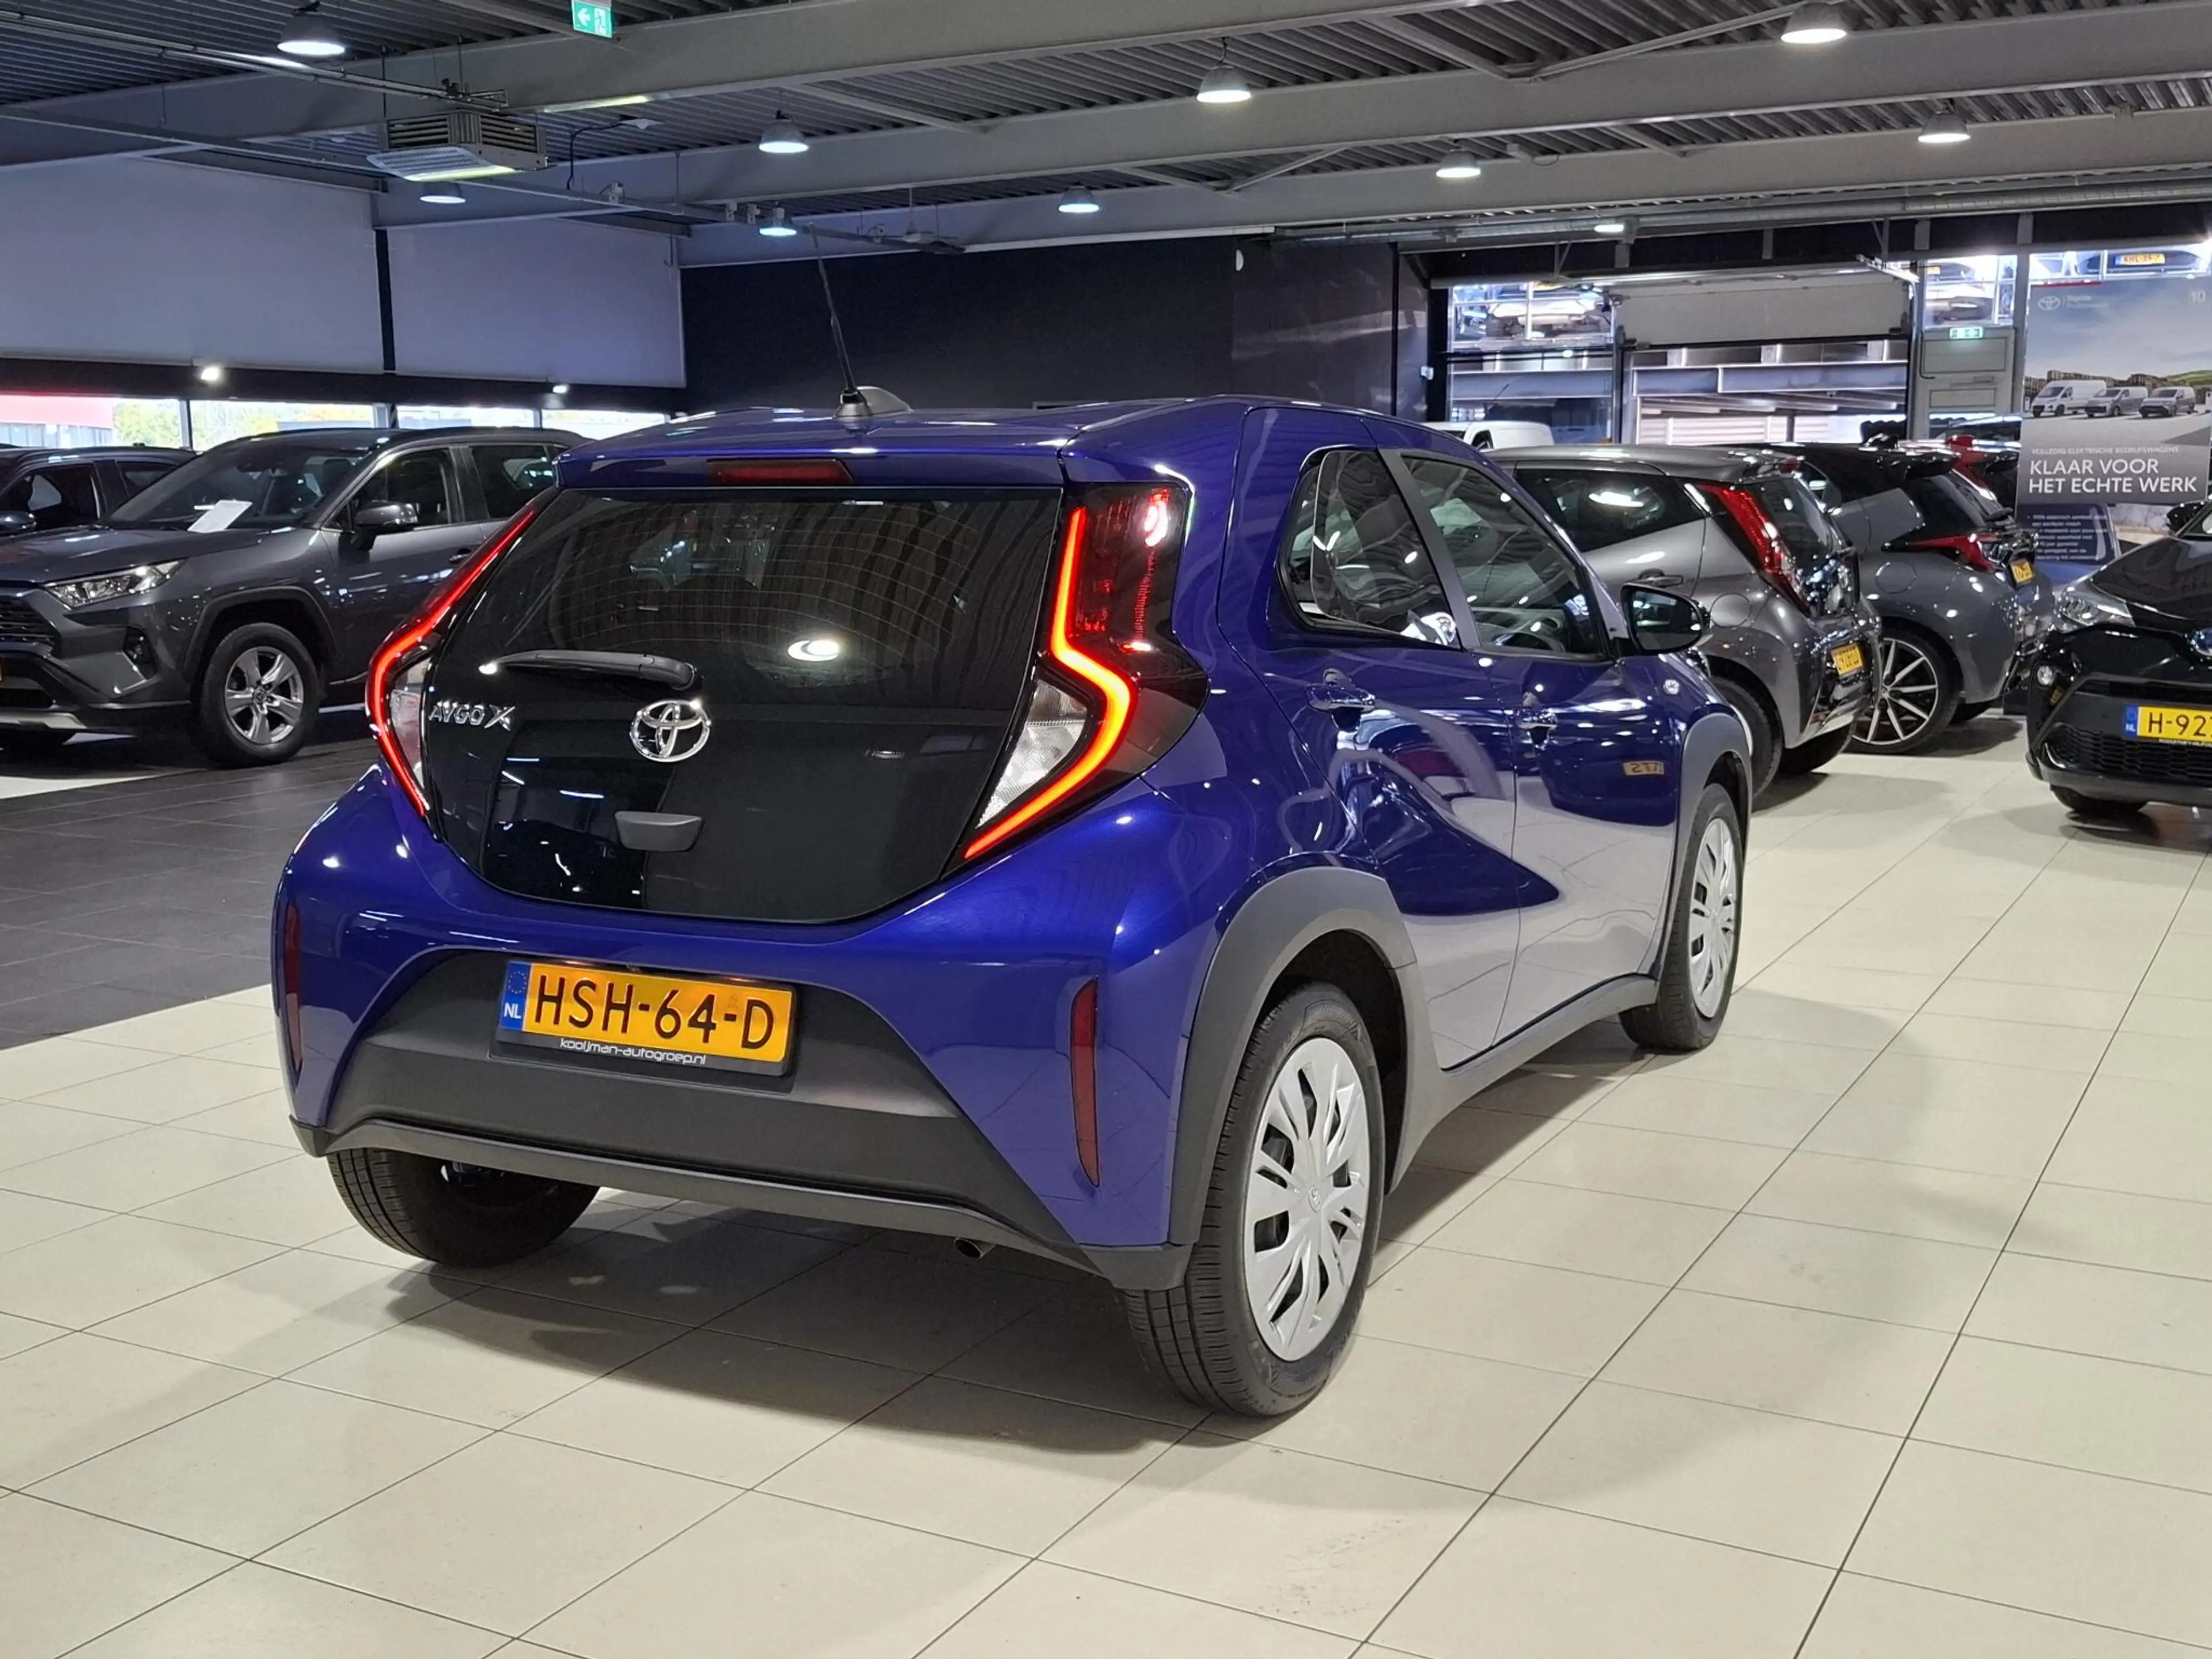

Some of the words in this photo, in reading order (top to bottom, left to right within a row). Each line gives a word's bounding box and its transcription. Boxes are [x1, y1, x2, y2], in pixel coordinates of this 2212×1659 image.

[2030, 460, 2093, 475] KLAAR
[2099, 459, 2158, 475] VOOR
[2029, 478, 2066, 494] HET
[2071, 478, 2133, 494] ECHTE
[2139, 476, 2198, 493] WERK
[2148, 711, 2212, 737] H-92
[503, 1002, 522, 1020] NL
[535, 975, 775, 1049] HSH-64-D
[560, 1037, 707, 1066] kooijman-autogroep.nl
